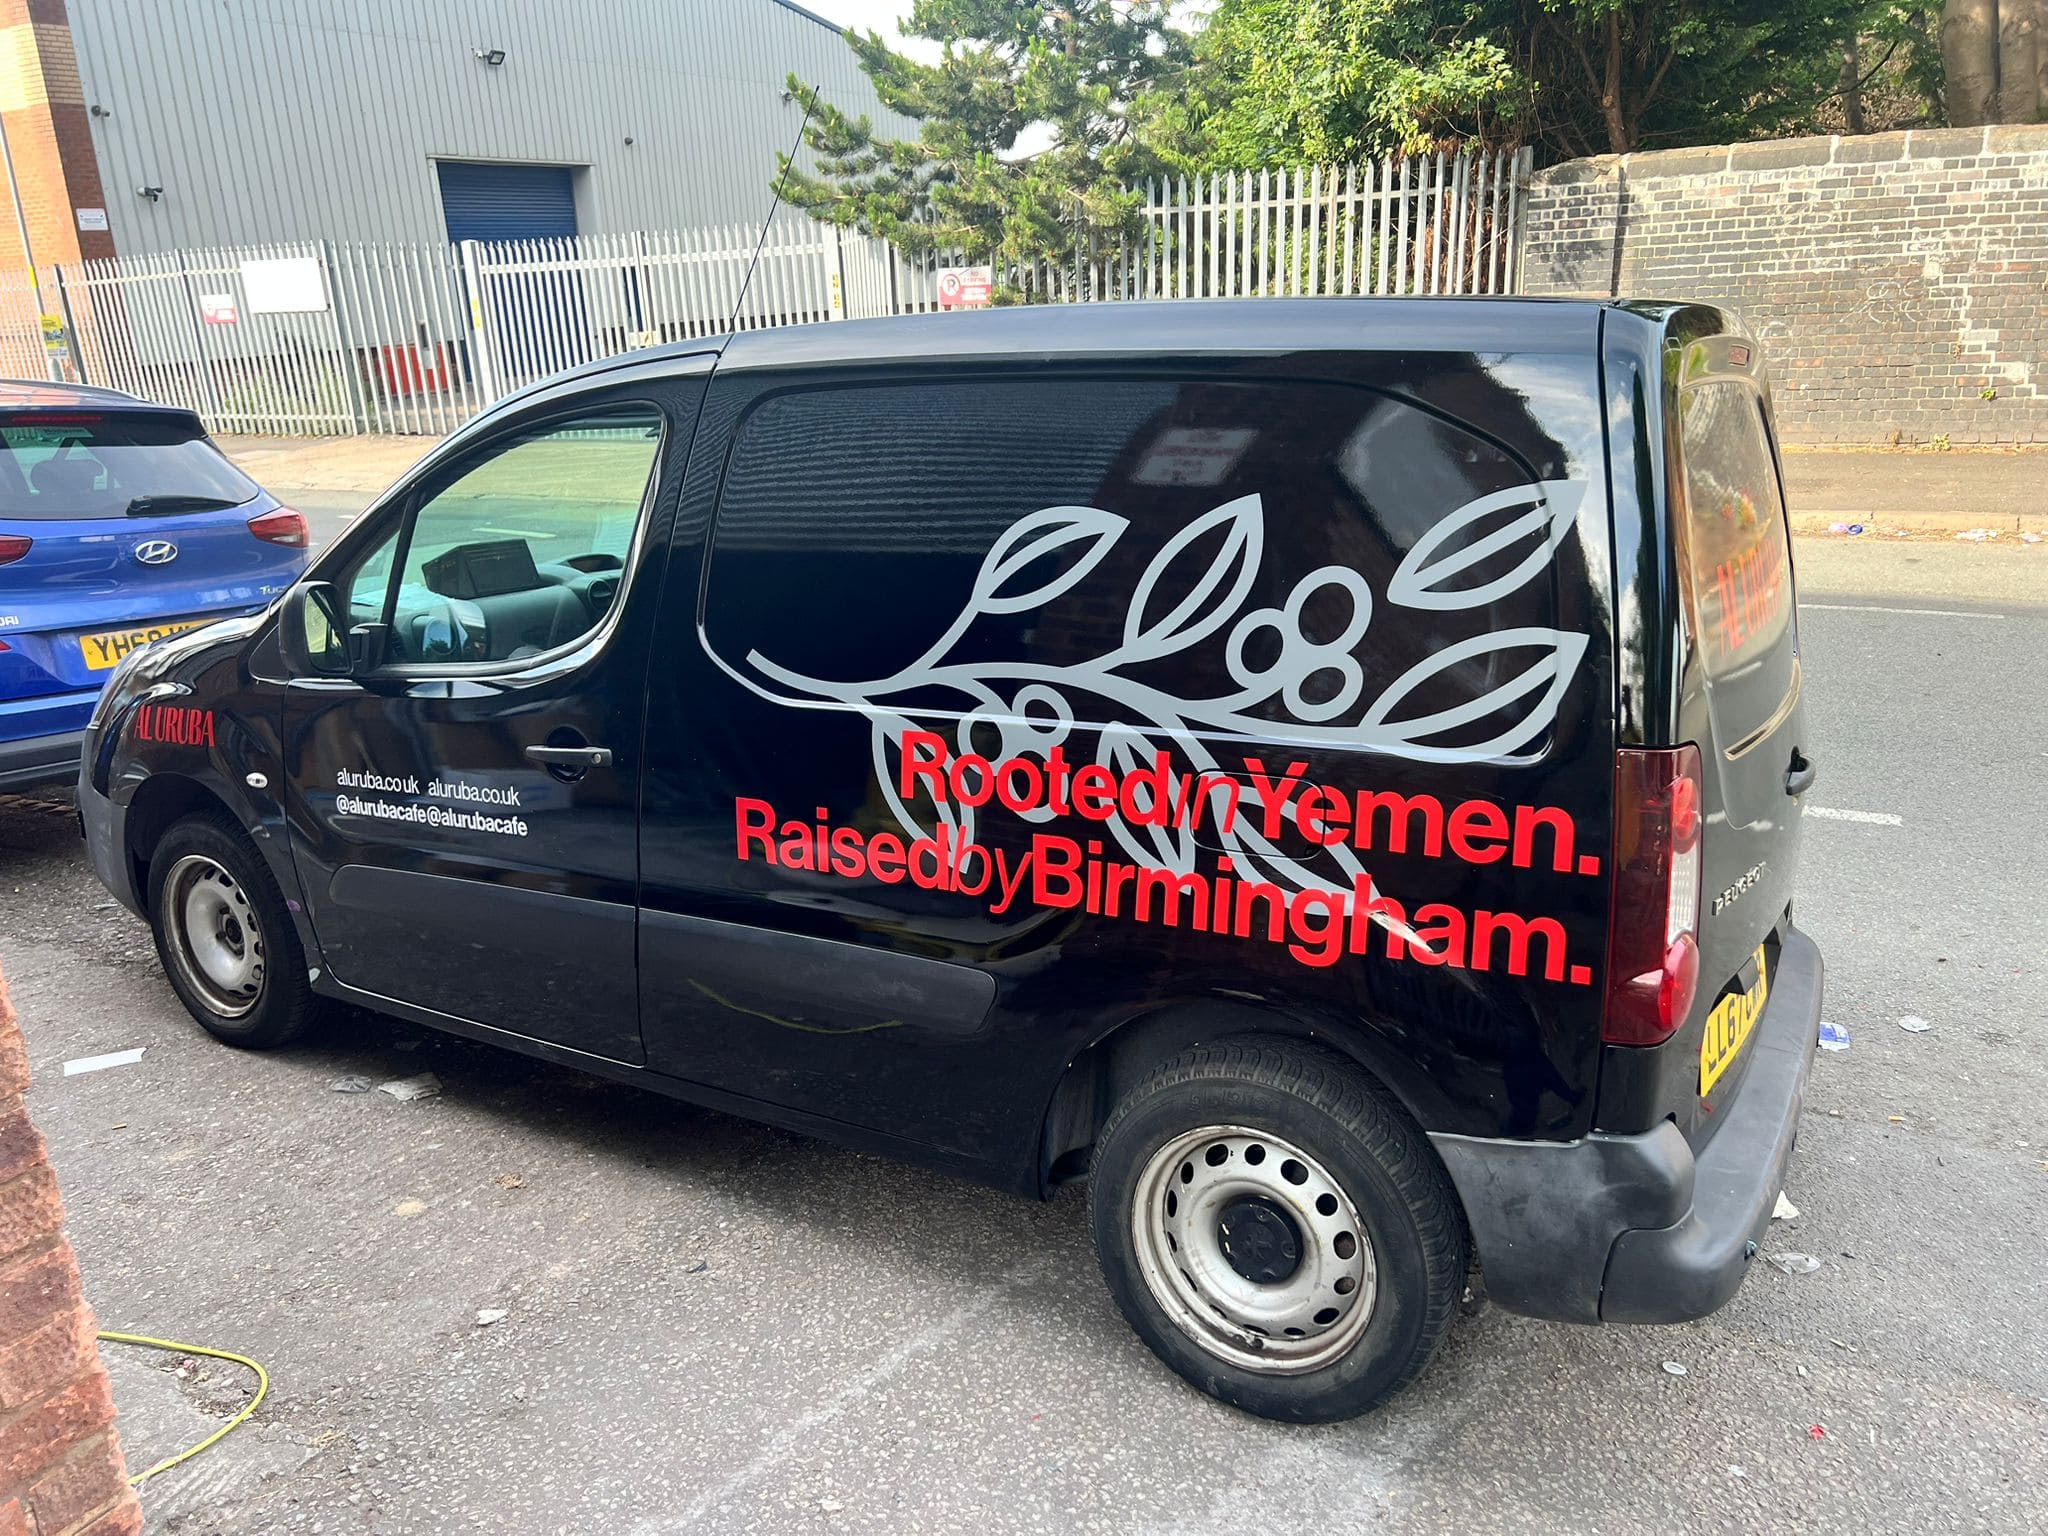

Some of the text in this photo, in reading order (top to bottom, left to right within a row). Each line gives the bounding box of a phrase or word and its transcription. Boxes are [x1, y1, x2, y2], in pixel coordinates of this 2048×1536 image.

[134, 704, 215, 747] AL URUBA
[337, 768, 521, 806] aluruba.couk aluruba.co.uk
[900, 730, 1170, 827] Rooted
[1243, 757, 1600, 877] Yemen.
[336, 794, 528, 836] @alurubacafe @alurubacafe
[735, 796, 1592, 986] Raised by Birmingham.
[1711, 860, 1768, 917] PEUGEOT
